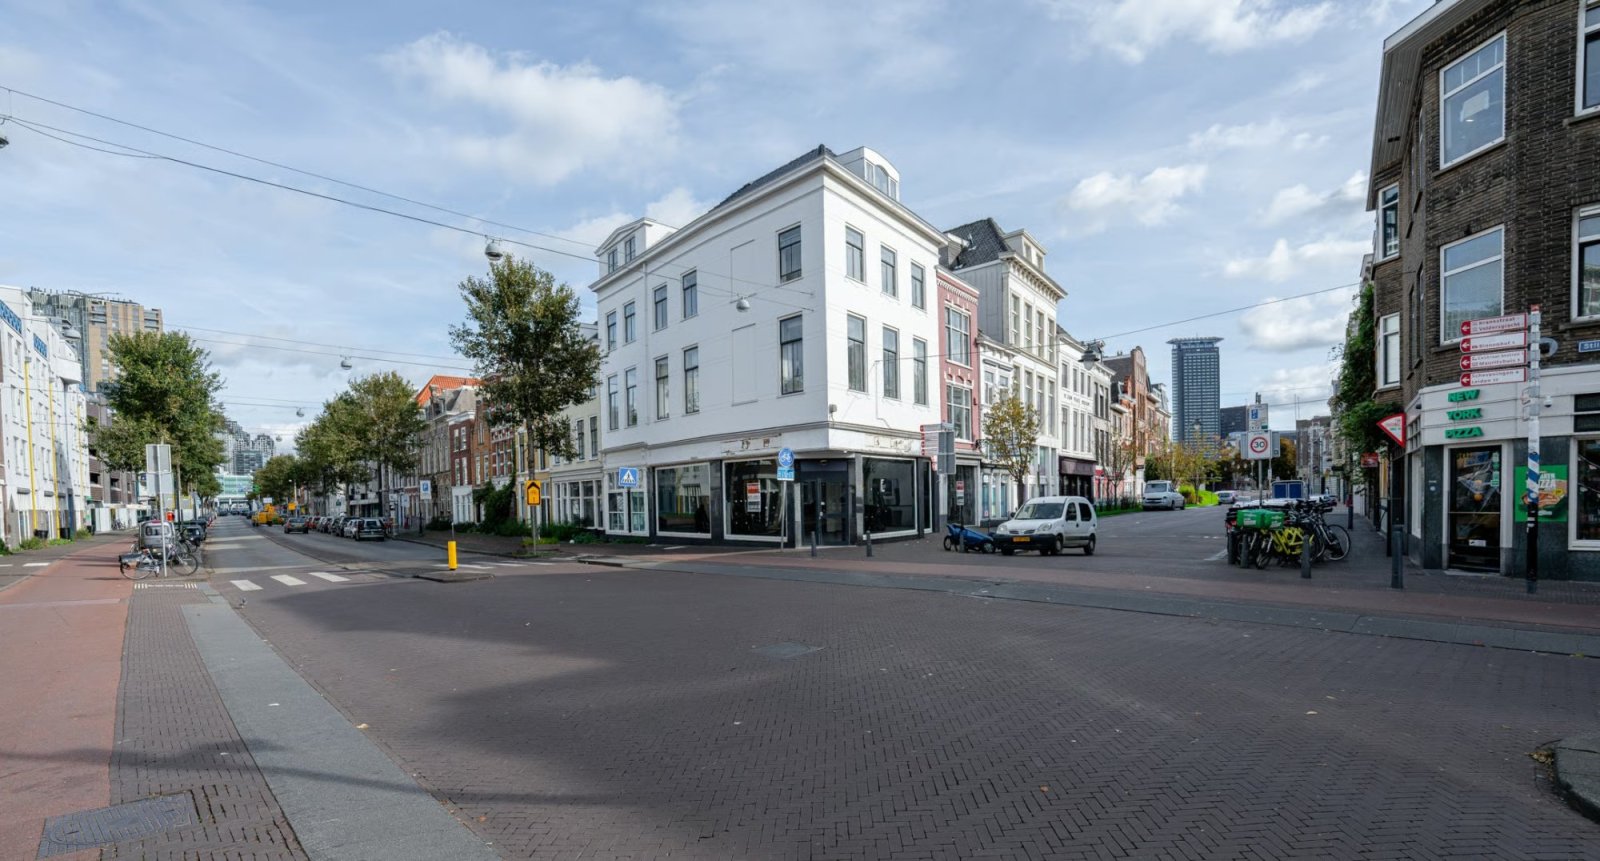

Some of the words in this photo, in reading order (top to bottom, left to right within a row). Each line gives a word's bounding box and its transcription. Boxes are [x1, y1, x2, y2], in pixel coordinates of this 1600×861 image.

[1448, 389, 1481, 402] NEW
[1446, 408, 1483, 421] YORK
[1445, 427, 1484, 439] PIZZA
[1254, 441, 1265, 449] 30
